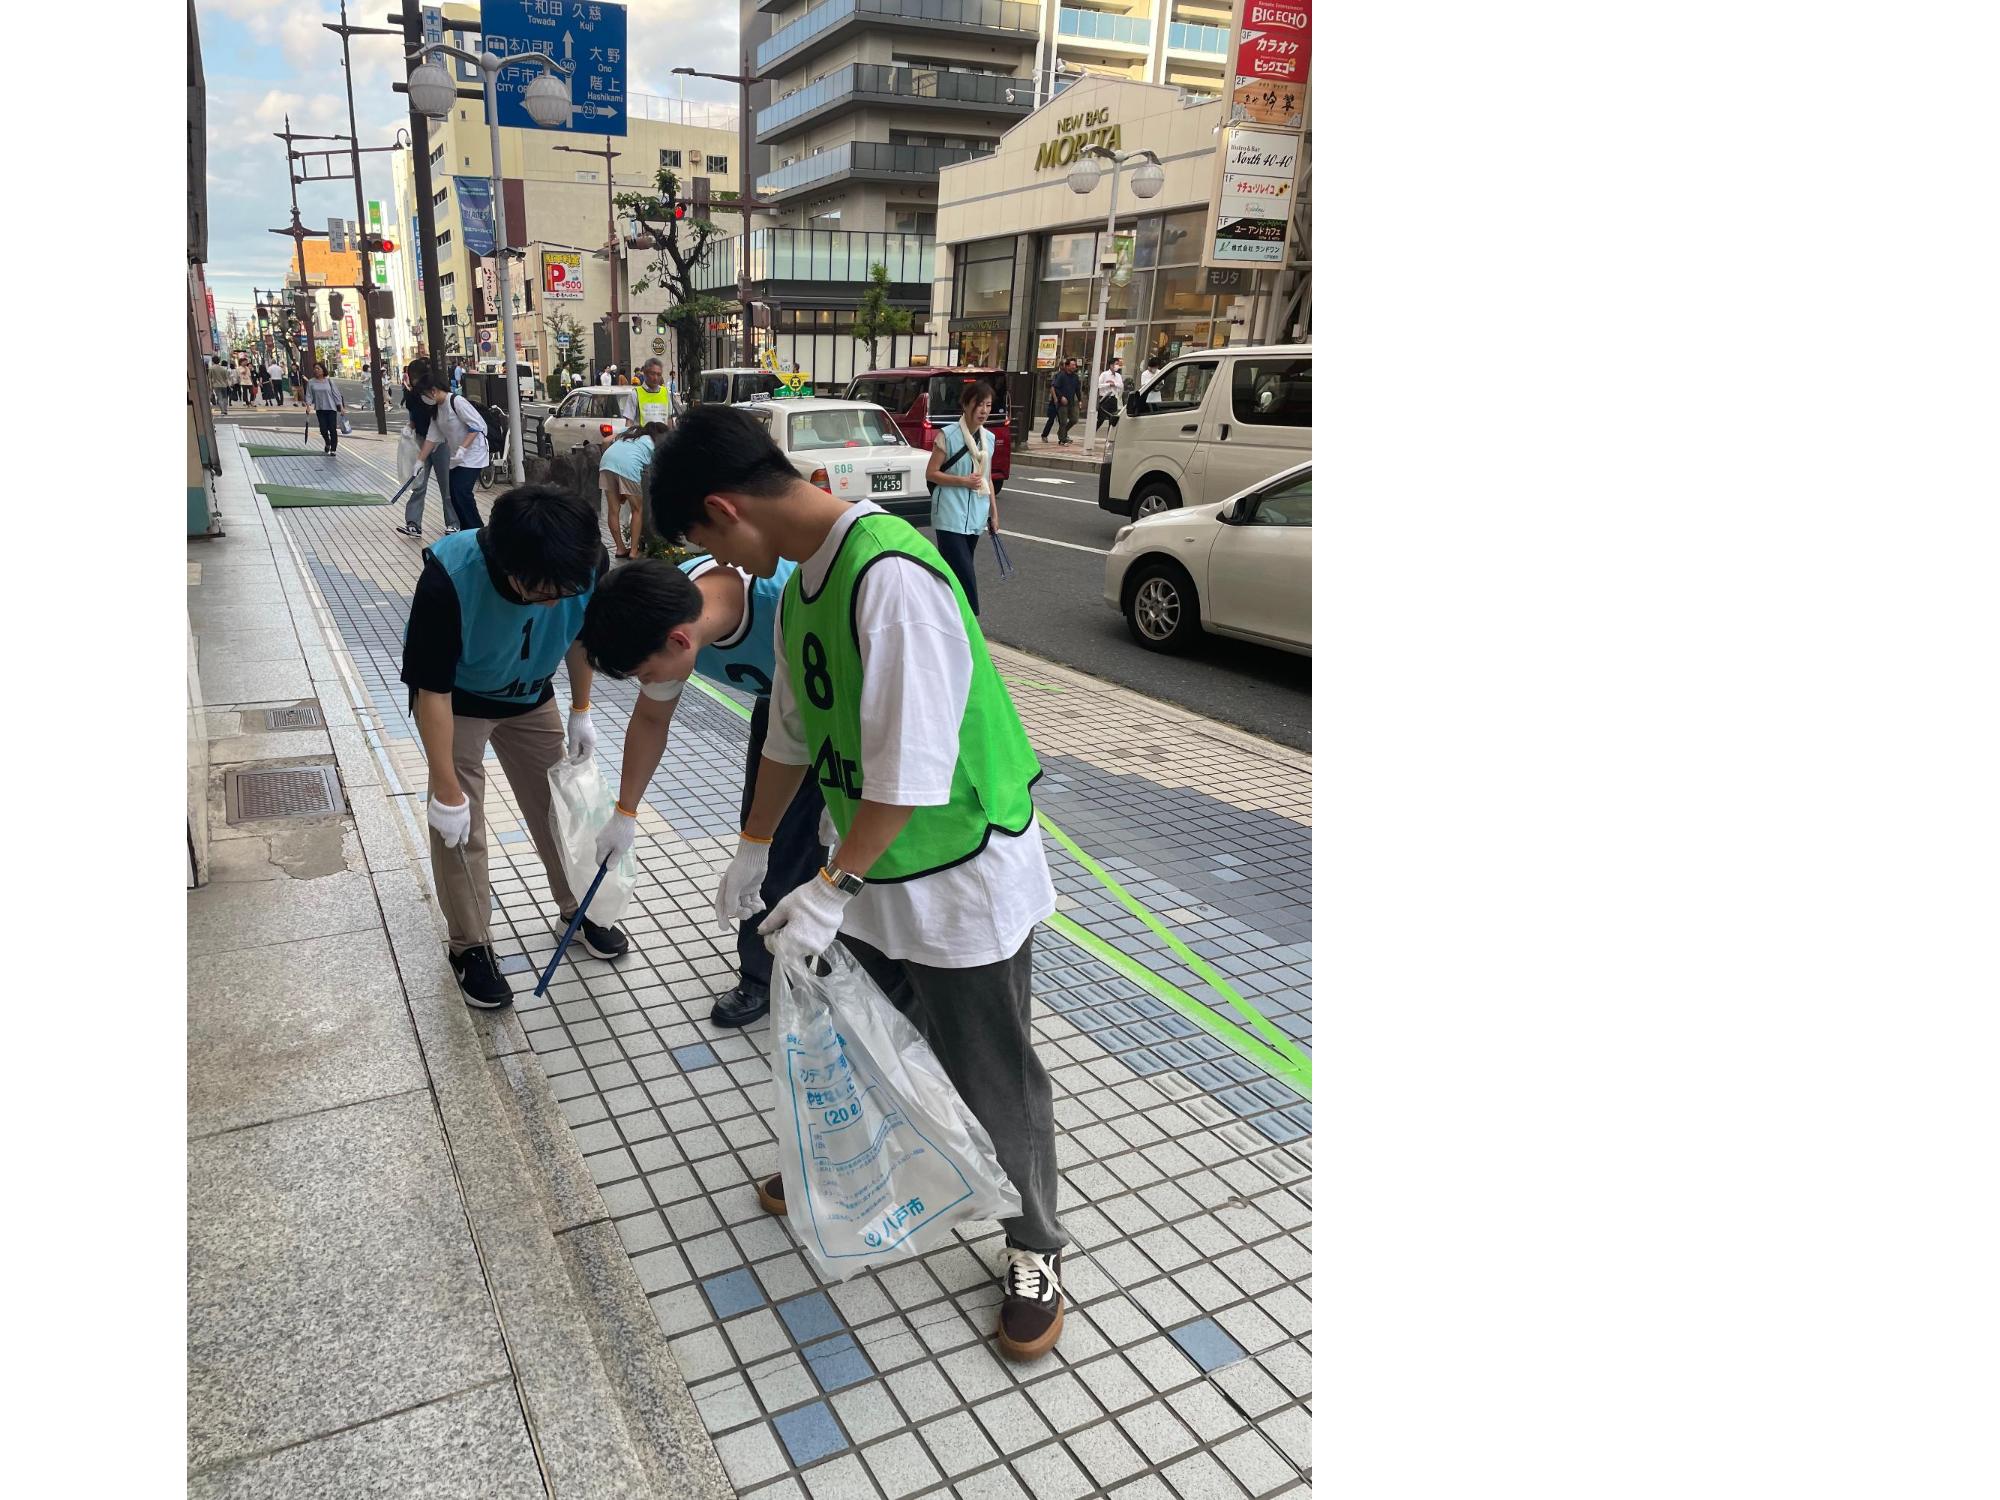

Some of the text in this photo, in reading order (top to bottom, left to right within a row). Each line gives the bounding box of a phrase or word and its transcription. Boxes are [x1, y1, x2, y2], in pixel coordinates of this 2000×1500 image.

[520, 0, 602, 20] 十和田 久慈
[1252, 7, 1308, 29] BIG ECHO
[528, 15, 594, 32] Towada Kuji
[1242, 31, 1252, 40] 3F
[509, 38, 554, 56] 本八戸駅
[590, 46, 620, 63] 大野
[1256, 38, 1299, 55] カラオケ
[562, 61, 575, 71] 340
[598, 64, 613, 73] Ono
[1255, 58, 1296, 74] ビッグエコー
[497, 83, 514, 92] CITY
[590, 75, 620, 92] 階上
[1236, 77, 1247, 85] 2F
[587, 92, 623, 102] Hashikami
[1057, 107, 1109, 134] NEW BAG
[1034, 124, 1121, 171] MORITA
[1232, 151, 1261, 165] North
[1265, 227, 1280, 236] カフェ
[1210, 271, 1240, 285] モリタ
[879, 480, 901, 491] 14-59
[521, 616, 534, 661] 1
[803, 631, 835, 711] 8
[881, 1196, 926, 1238] 八戸市
